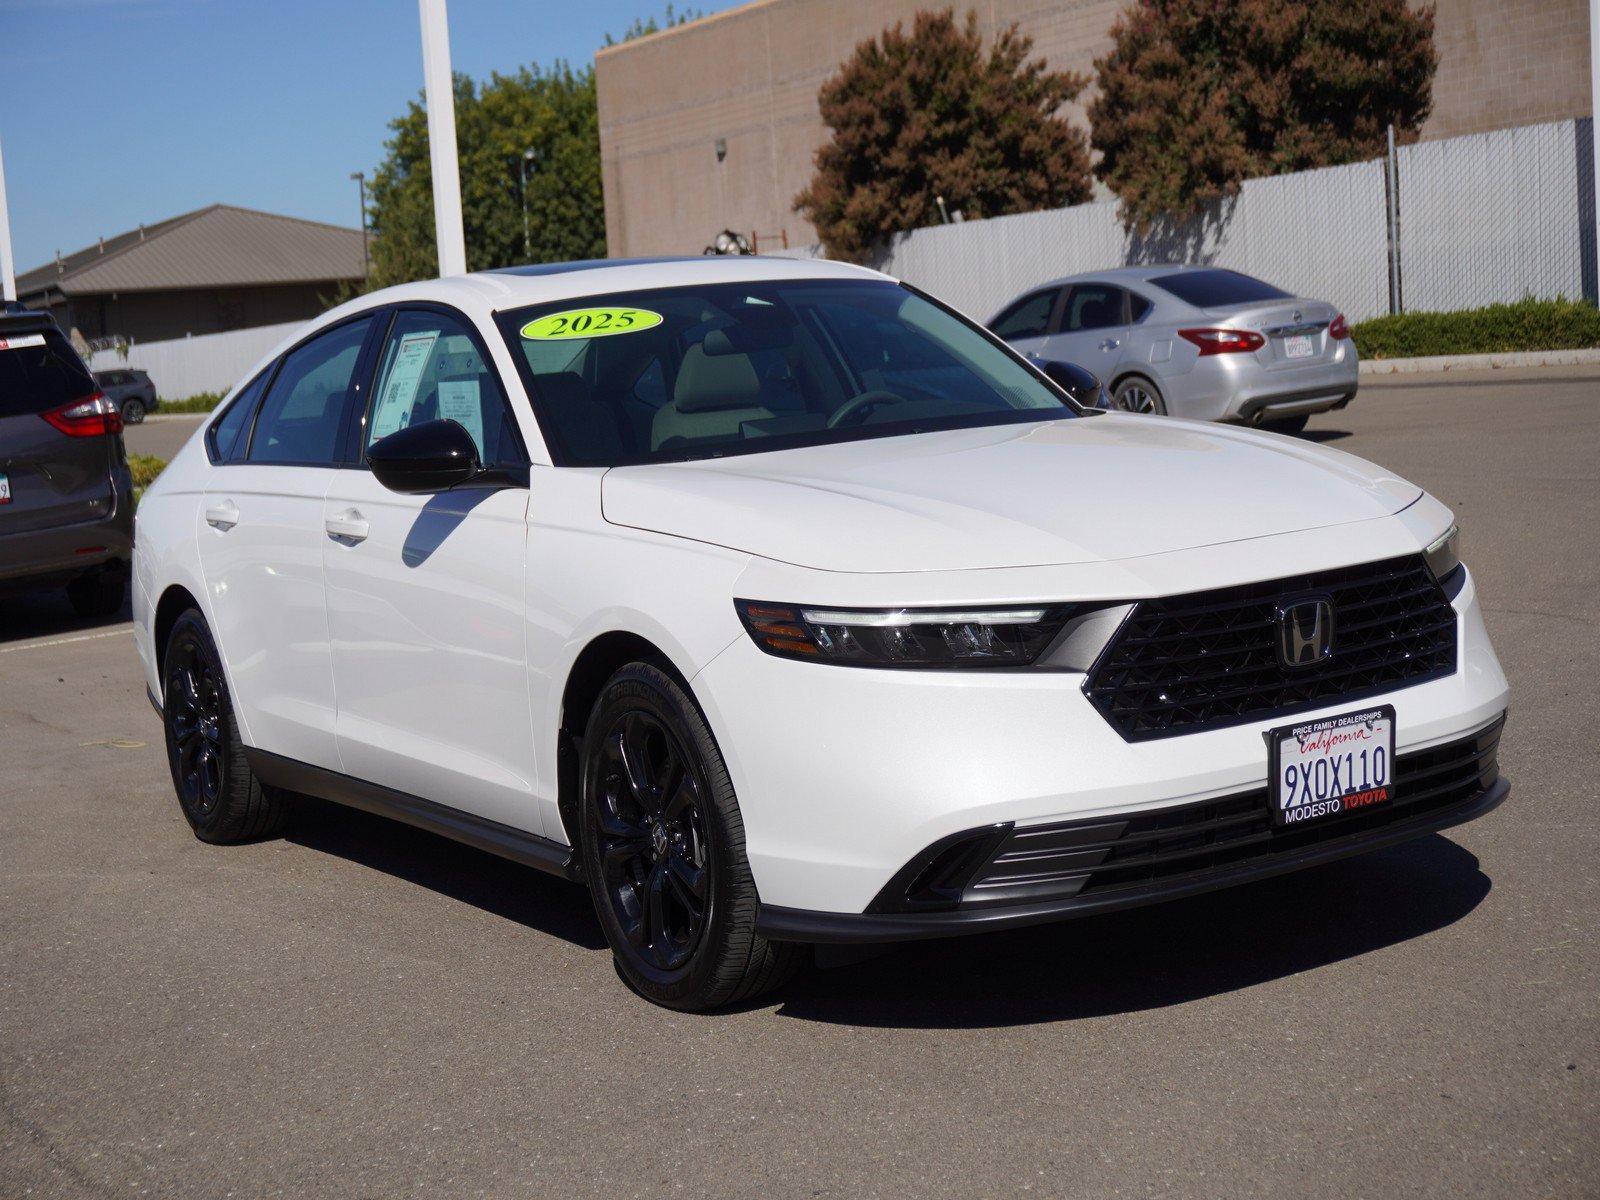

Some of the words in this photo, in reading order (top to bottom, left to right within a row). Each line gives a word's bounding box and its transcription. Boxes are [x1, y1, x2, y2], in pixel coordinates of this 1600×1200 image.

[549, 312, 636, 336] 2025
[1292, 726, 1312, 737] PRICE
[1313, 720, 1338, 732] FAMILY
[1338, 711, 1382, 727] DEALERSHIPS
[1300, 727, 1372, 755] California
[1285, 799, 1340, 824] MODESTO
[1342, 788, 1388, 810] TOYOTA
